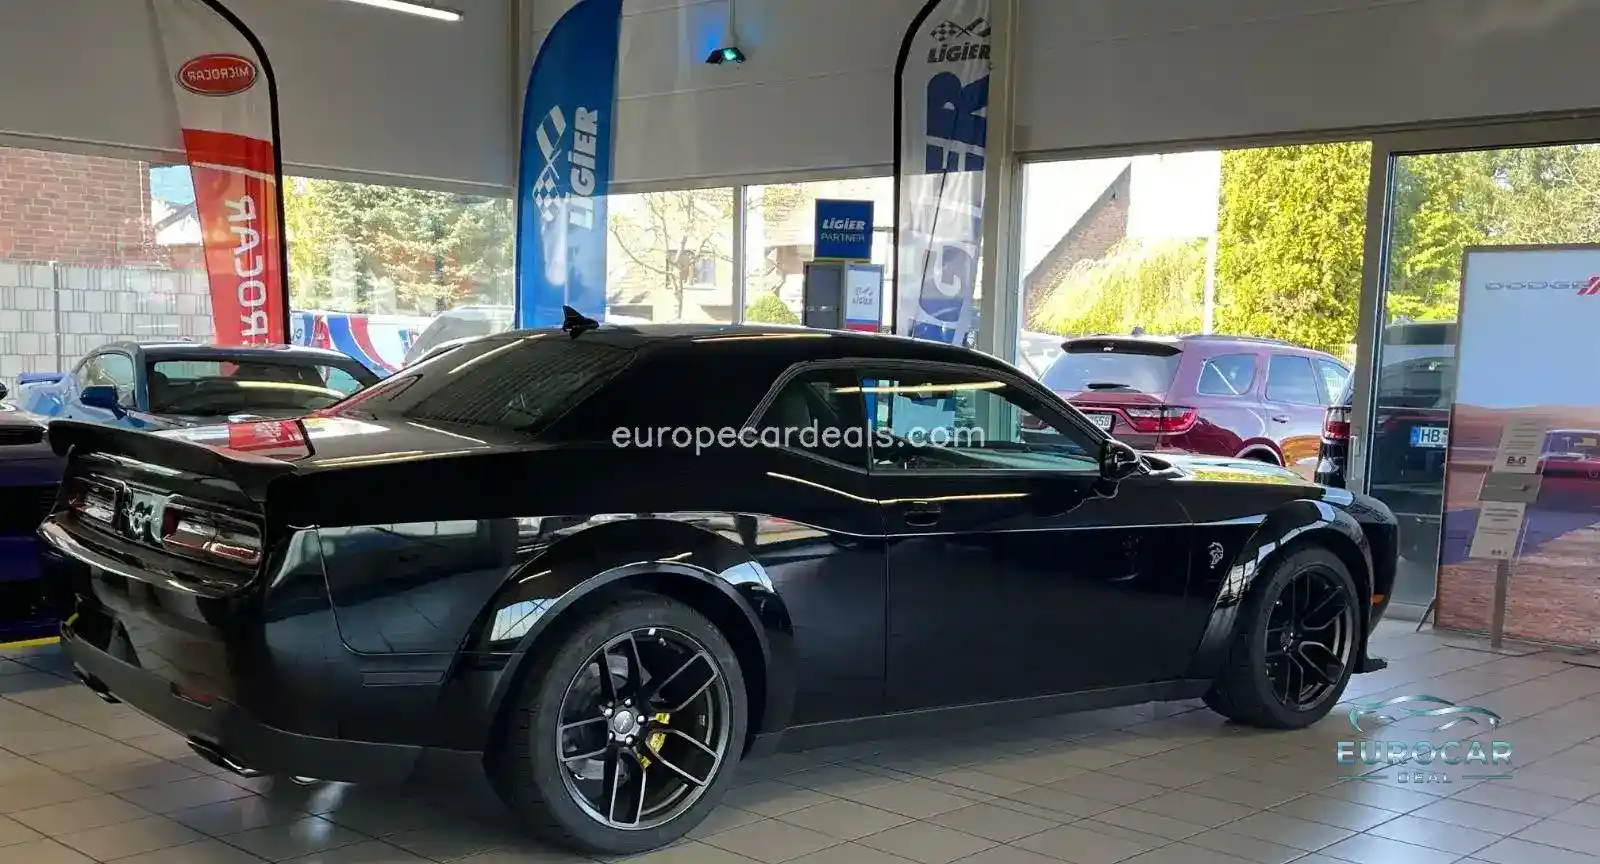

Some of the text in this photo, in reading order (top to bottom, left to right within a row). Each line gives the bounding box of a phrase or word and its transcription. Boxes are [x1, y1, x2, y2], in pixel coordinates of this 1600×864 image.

[566, 106, 598, 230] LIGIER
[822, 217, 867, 230] LIGIER
[820, 232, 865, 243] PARTNER
[1485, 280, 1589, 291] DODGE
